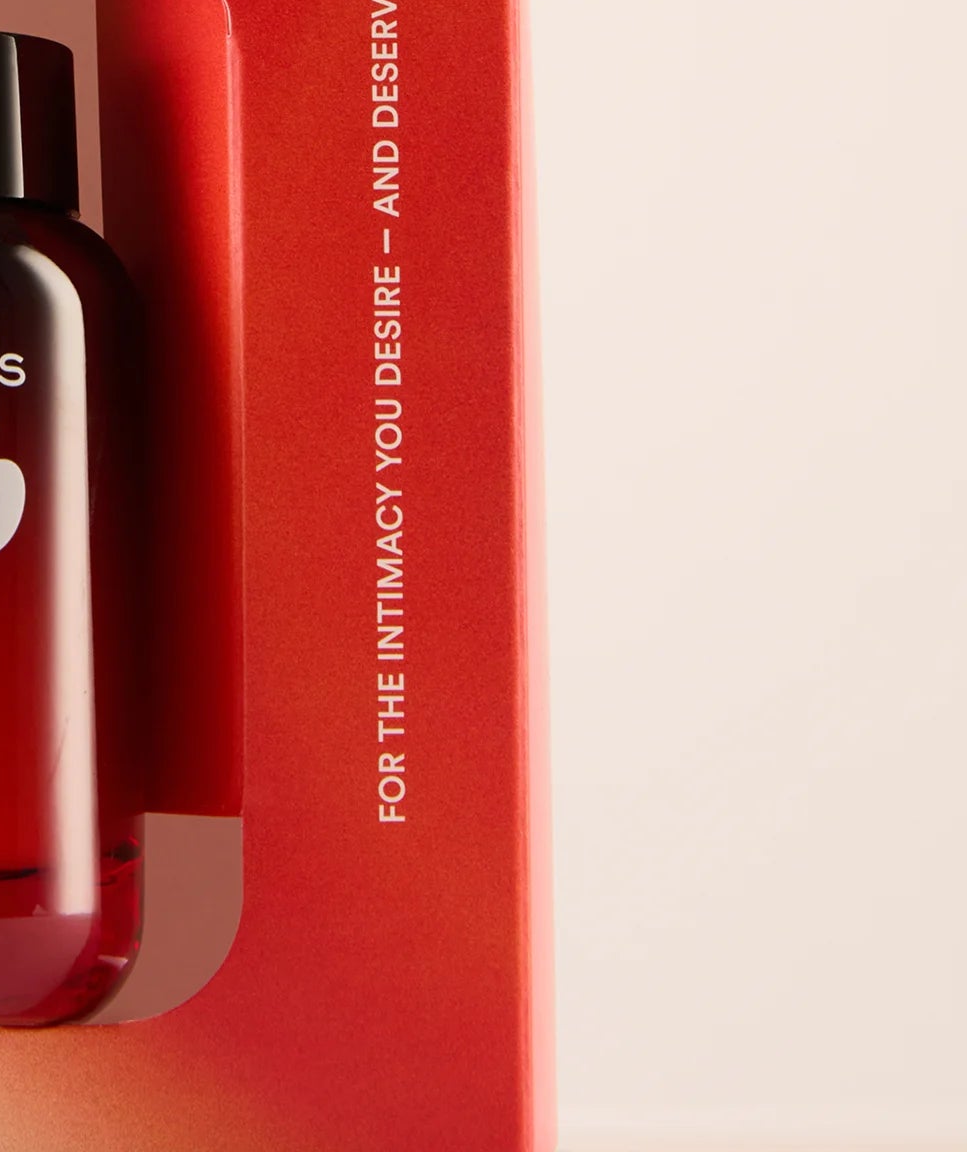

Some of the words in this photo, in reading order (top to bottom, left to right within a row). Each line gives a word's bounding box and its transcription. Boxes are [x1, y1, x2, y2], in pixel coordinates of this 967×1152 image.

[372, 140, 400, 218] AND
[373, 266, 402, 386] DESIRE
[374, 399, 403, 472] YOU
[375, 482, 405, 661] INTIMACY
[377, 673, 406, 743] THE
[378, 753, 407, 823] FOR
